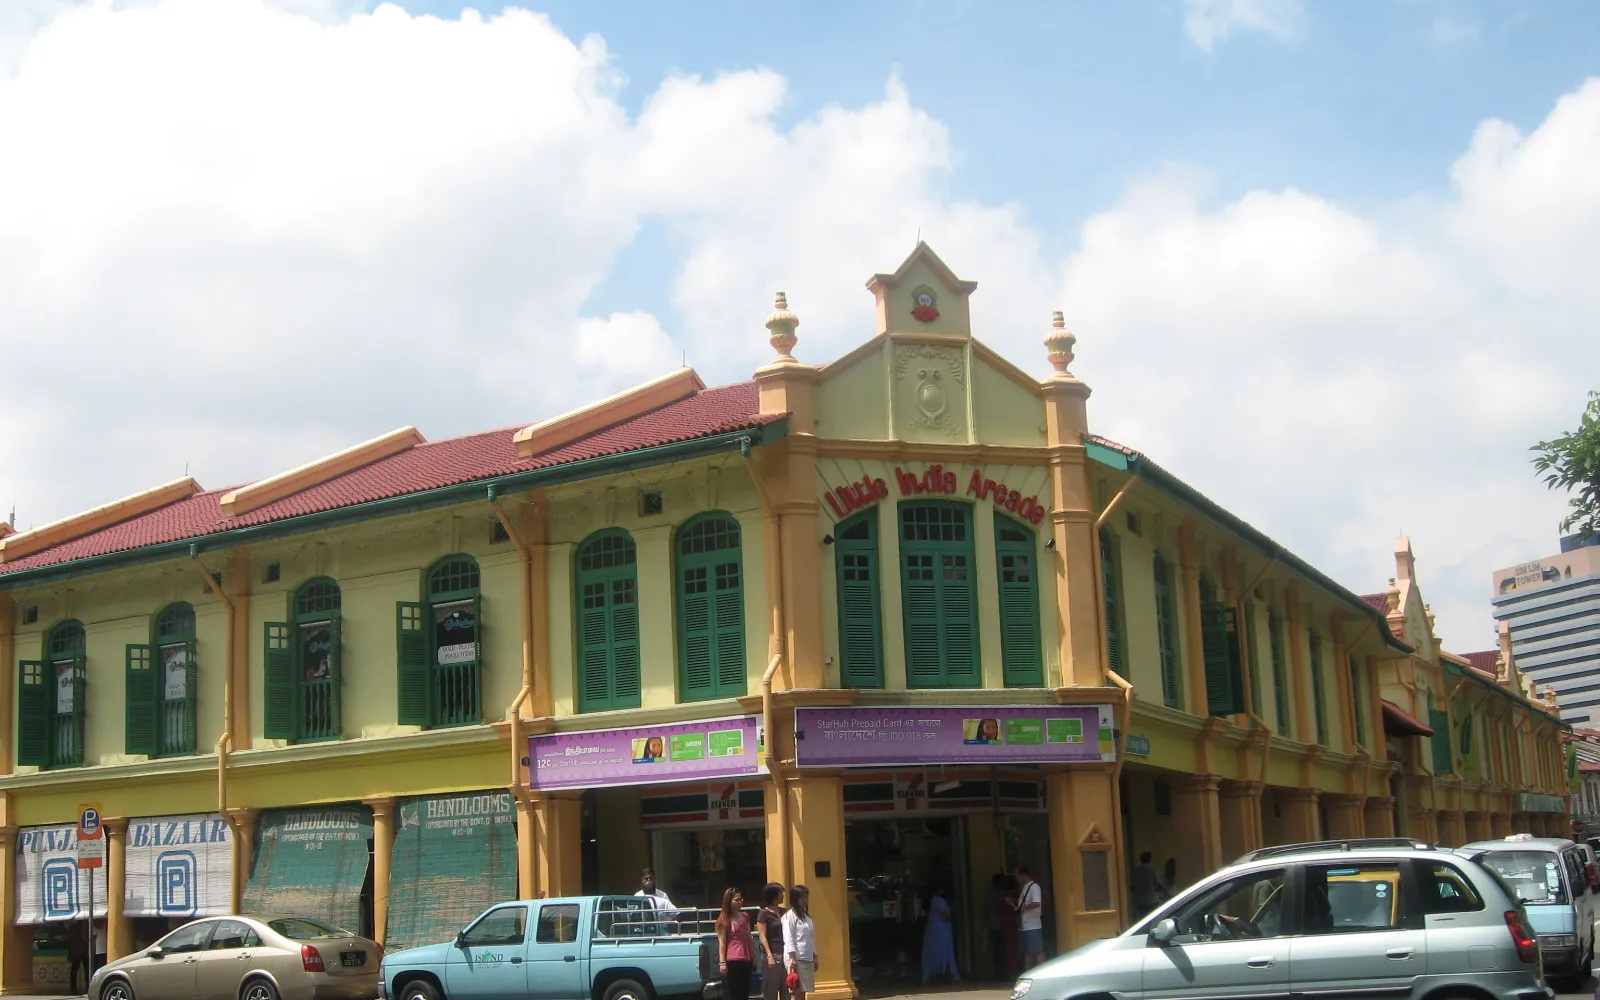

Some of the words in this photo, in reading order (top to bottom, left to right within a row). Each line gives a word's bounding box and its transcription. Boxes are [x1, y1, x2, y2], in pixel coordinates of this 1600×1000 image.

[825, 475, 889, 518] Little
[895, 464, 957, 495] India
[966, 469, 1046, 525] Arcade
[1515, 565, 1527, 576] SIM
[1528, 560, 1540, 573] LIM
[1516, 573, 1541, 586] TOWER
[817, 719, 849, 728] StarHub
[851, 719, 881, 729] Prepaid
[883, 719, 902, 727] Card
[906, 732, 922, 740] 018
[685, 740, 702, 748] GREEN
[427, 794, 510, 818] HANDLOOMS
[711, 799, 737, 809] ELEVEN
[84, 810, 97, 828] P
[284, 811, 360, 831] HANDLOOMS
[461, 818, 470, 826] THE
[132, 819, 228, 848] BAZAAR
